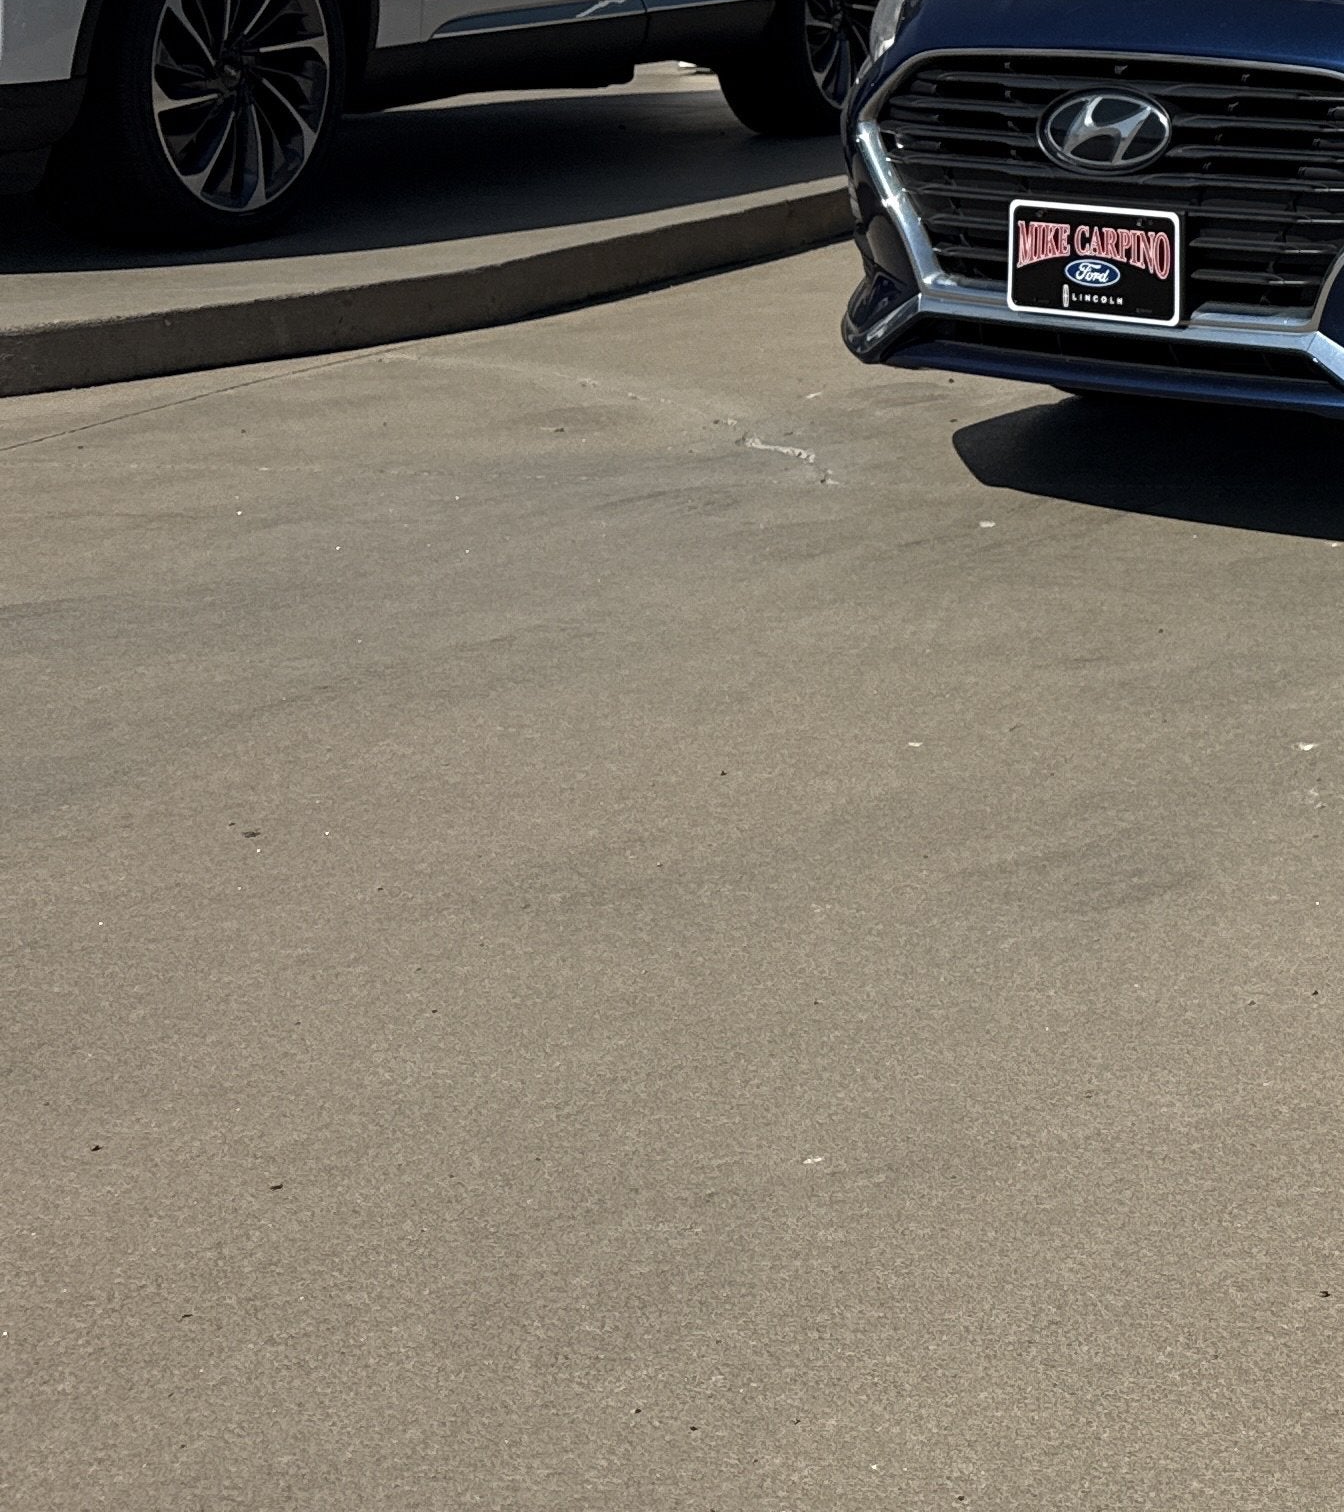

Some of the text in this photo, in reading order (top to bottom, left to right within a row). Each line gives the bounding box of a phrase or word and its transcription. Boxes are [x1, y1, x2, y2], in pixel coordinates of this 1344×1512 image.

[1017, 220, 1171, 280] MIKE CARPINO
[1075, 262, 1110, 282] Ford
[1071, 291, 1124, 306] LINCOLN
